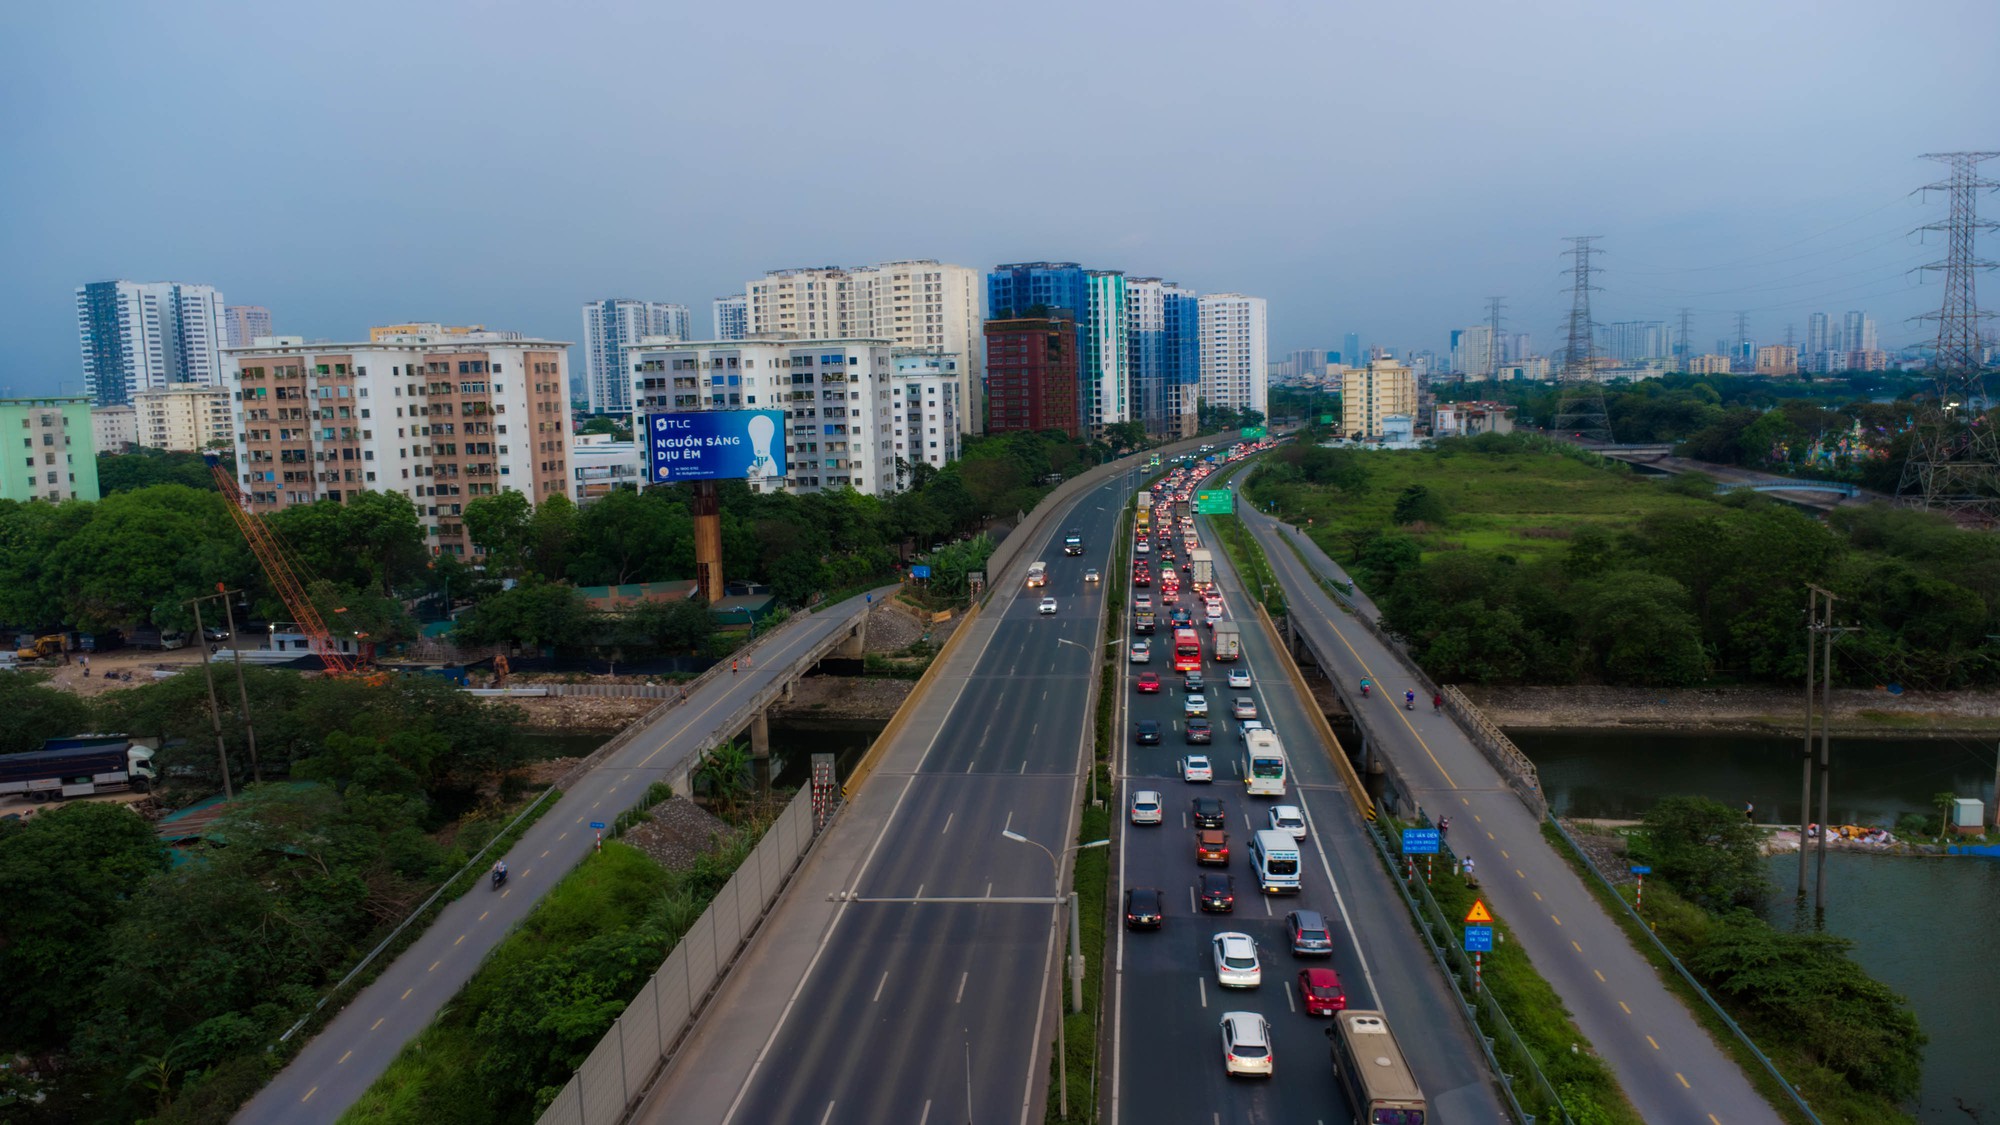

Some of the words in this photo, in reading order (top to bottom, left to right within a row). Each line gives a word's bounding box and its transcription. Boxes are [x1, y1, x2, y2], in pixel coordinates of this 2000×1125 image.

[668, 420, 691, 428] TLC
[657, 435, 702, 448] NGUỒN
[706, 435, 740, 446] SÁNG
[657, 451, 679, 462] DỊU
[683, 448, 700, 459] ÊM
